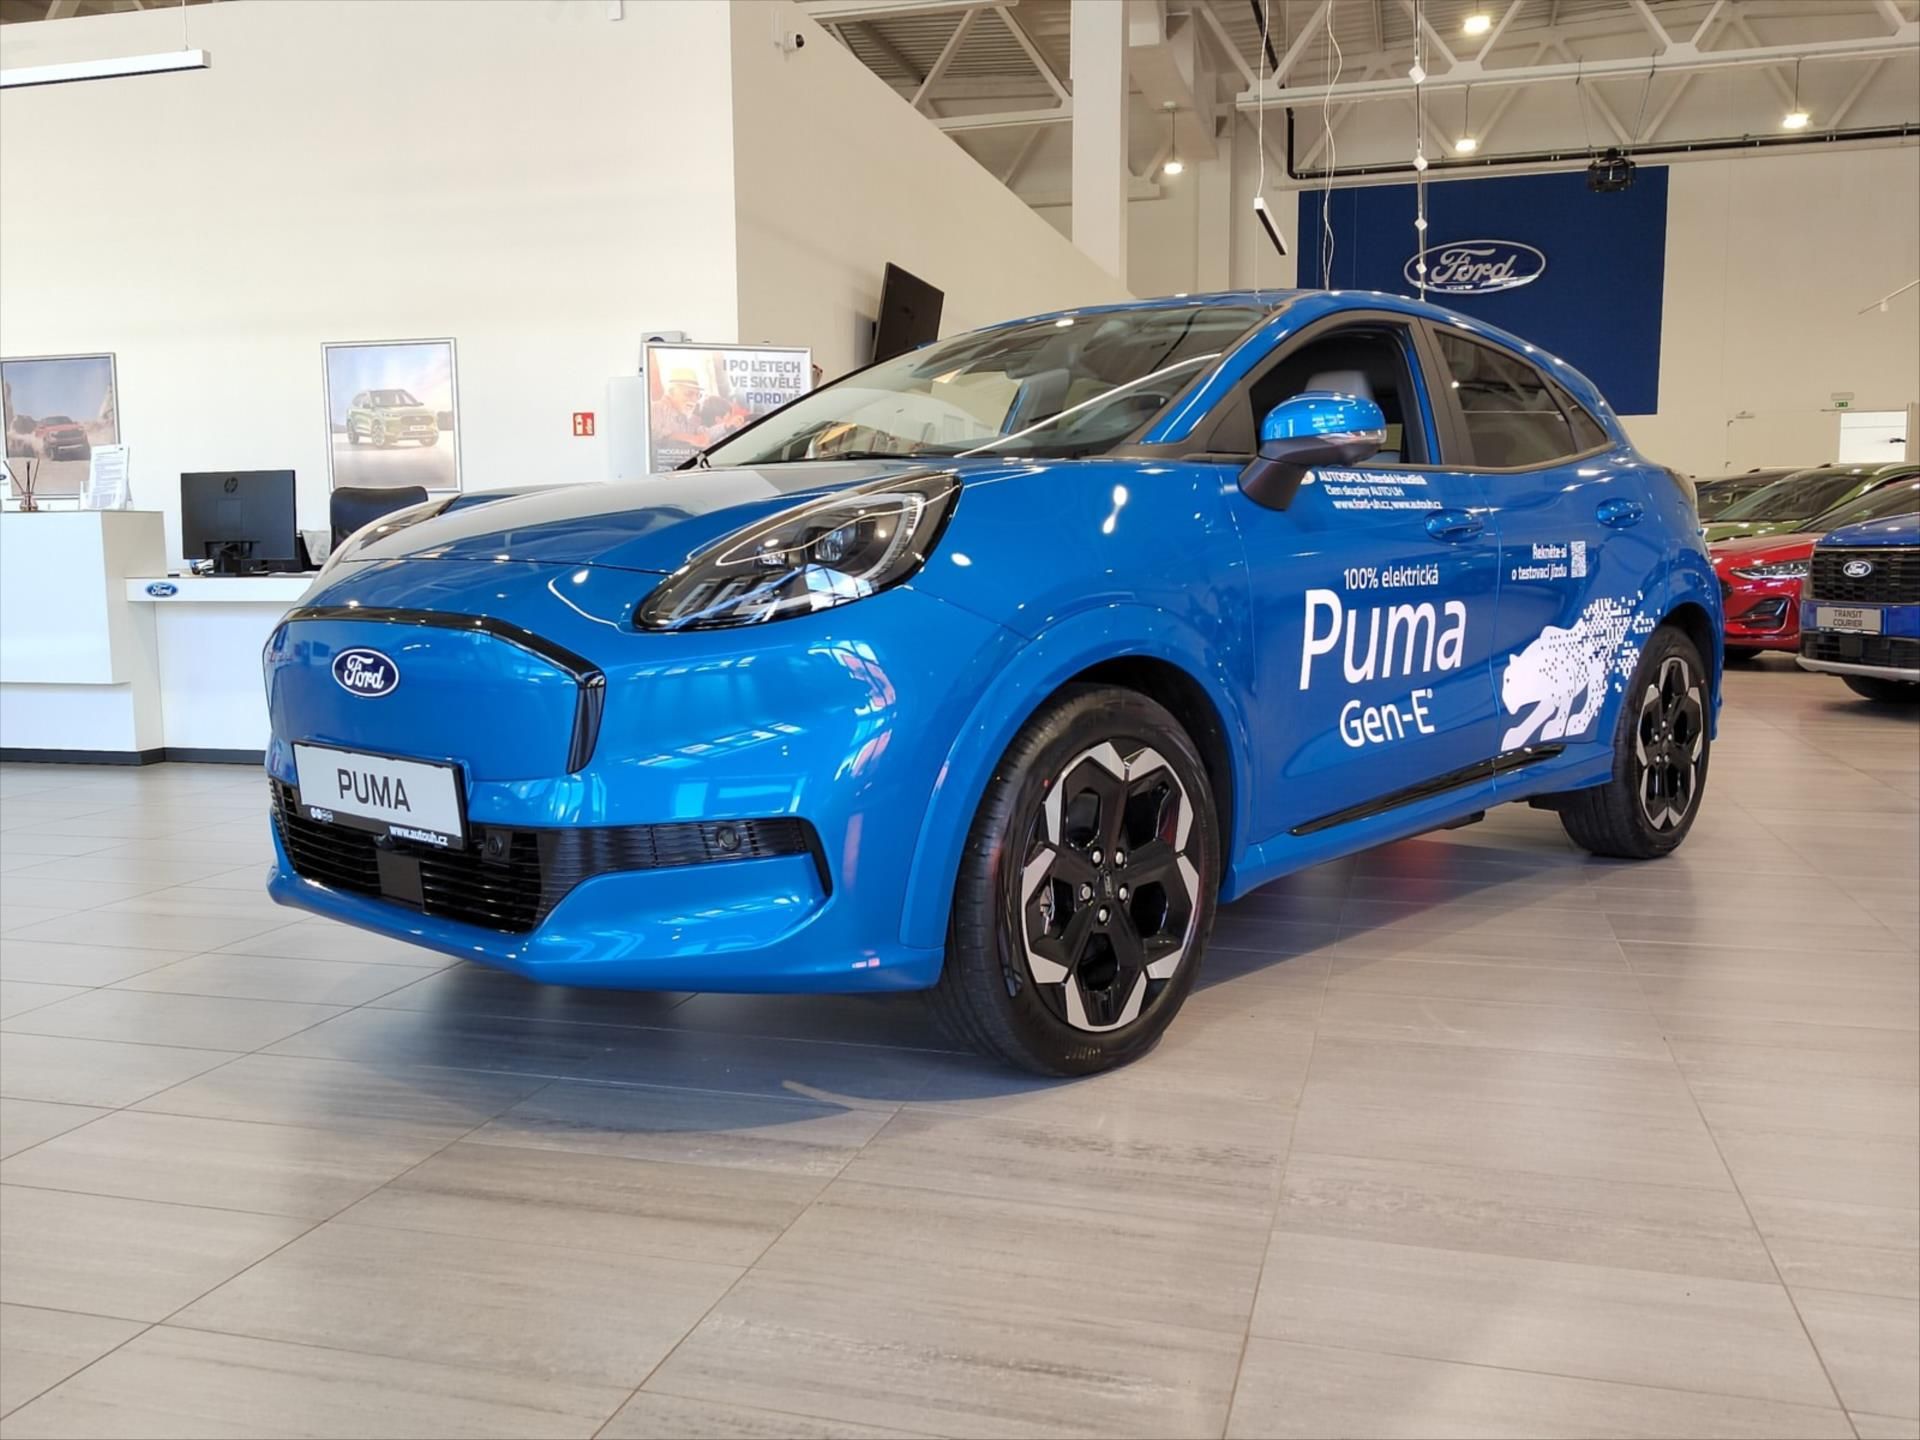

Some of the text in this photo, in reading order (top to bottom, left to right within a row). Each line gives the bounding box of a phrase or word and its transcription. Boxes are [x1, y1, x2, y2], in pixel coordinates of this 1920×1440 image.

[1430, 248, 1517, 283] Ford
[729, 359, 749, 372] PO
[751, 360, 801, 373] LETECH
[729, 373, 801, 389] VE SKVĚLÉ
[1343, 563, 1439, 591] 100% elektrická
[1511, 568, 1517, 581] o
[1833, 609, 1863, 618] TRANSIT
[1833, 618, 1863, 627] COURIER
[1299, 588, 1467, 691] Puma
[343, 654, 385, 690] Ford
[337, 768, 411, 812] PUMA
[388, 825, 449, 847] www.autouh.cz
